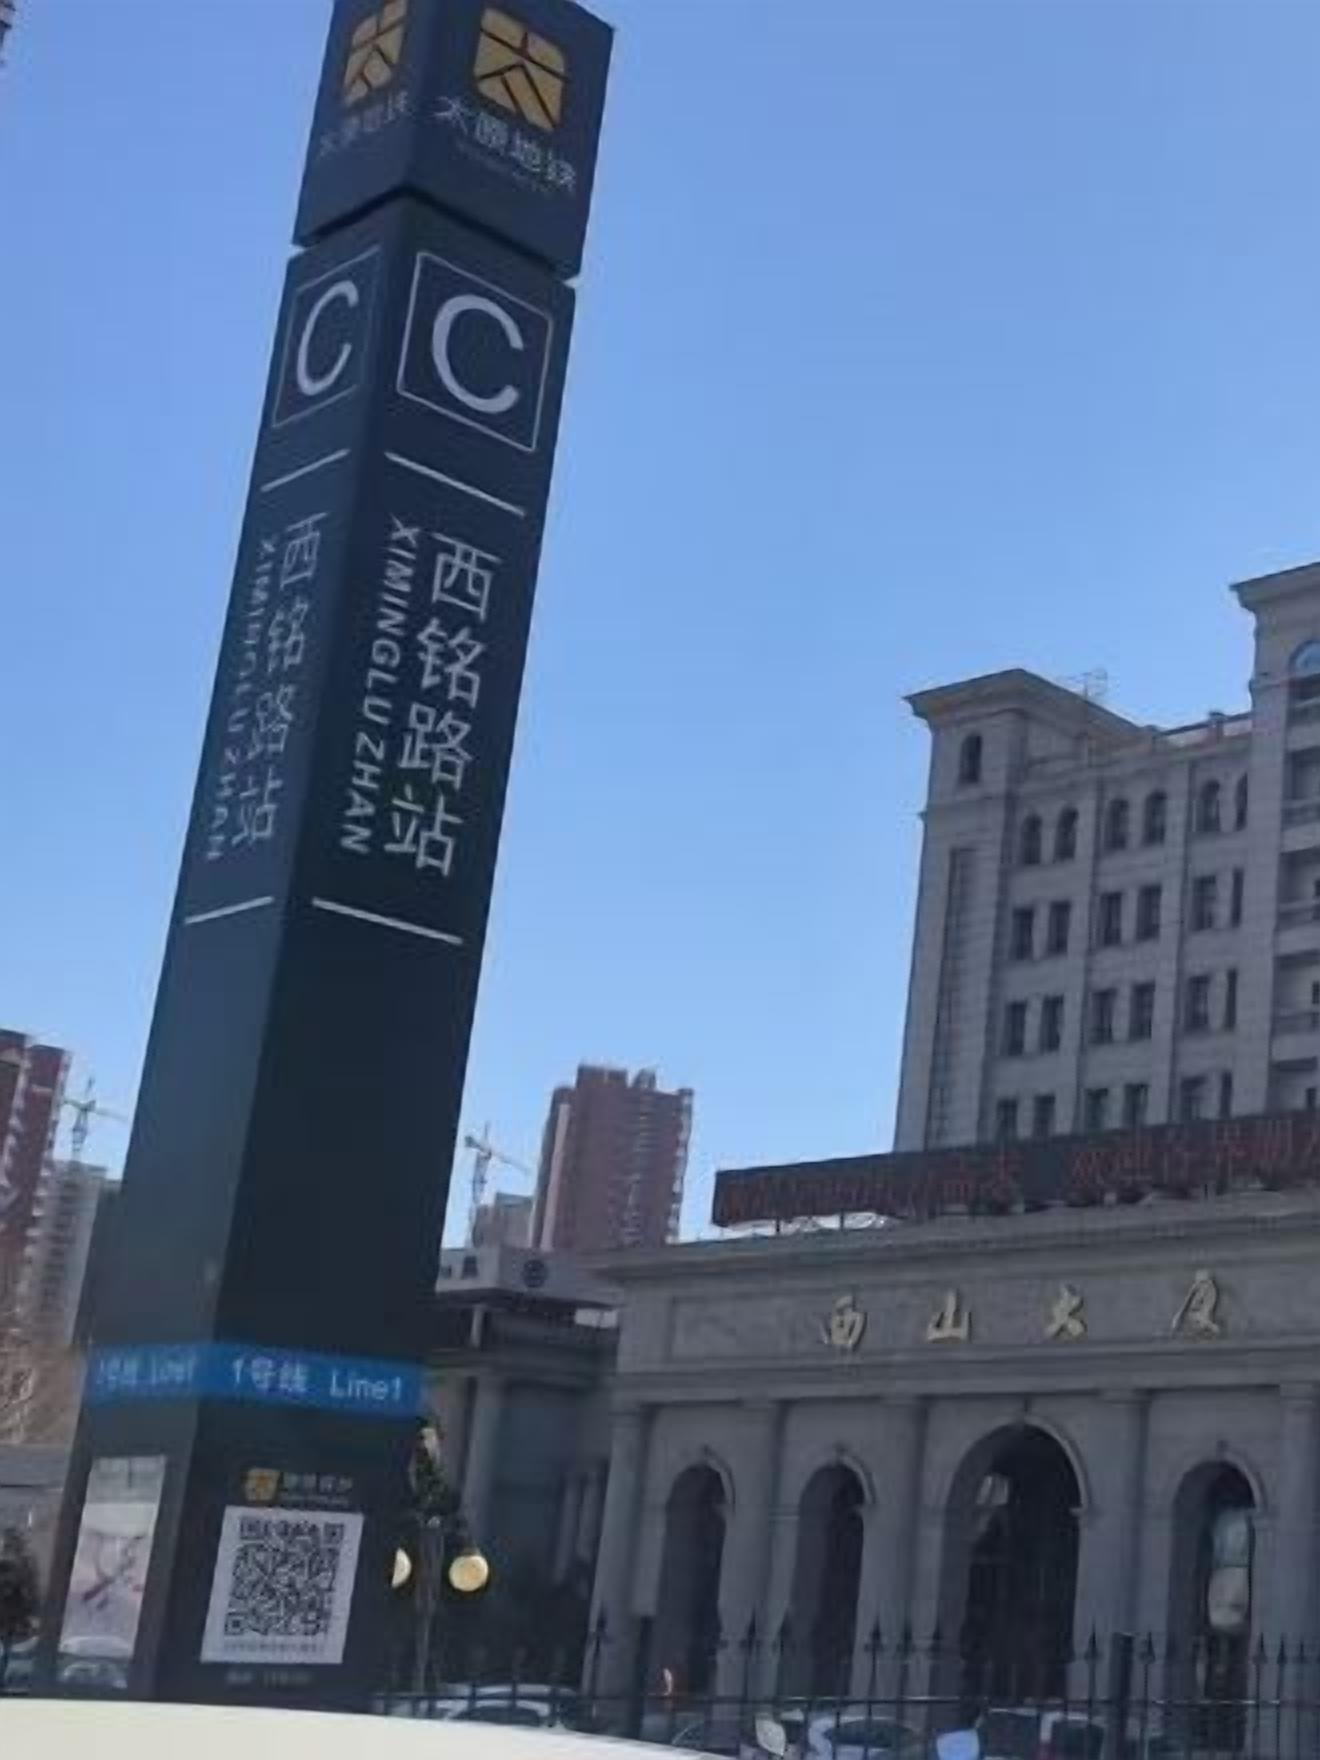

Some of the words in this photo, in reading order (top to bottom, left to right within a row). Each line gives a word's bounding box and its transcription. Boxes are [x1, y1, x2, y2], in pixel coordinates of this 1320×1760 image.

[297, 280, 359, 396] C
[432, 294, 524, 413] C
[231, 512, 328, 846] 西铭路站
[384, 530, 503, 877] 西铭路站
